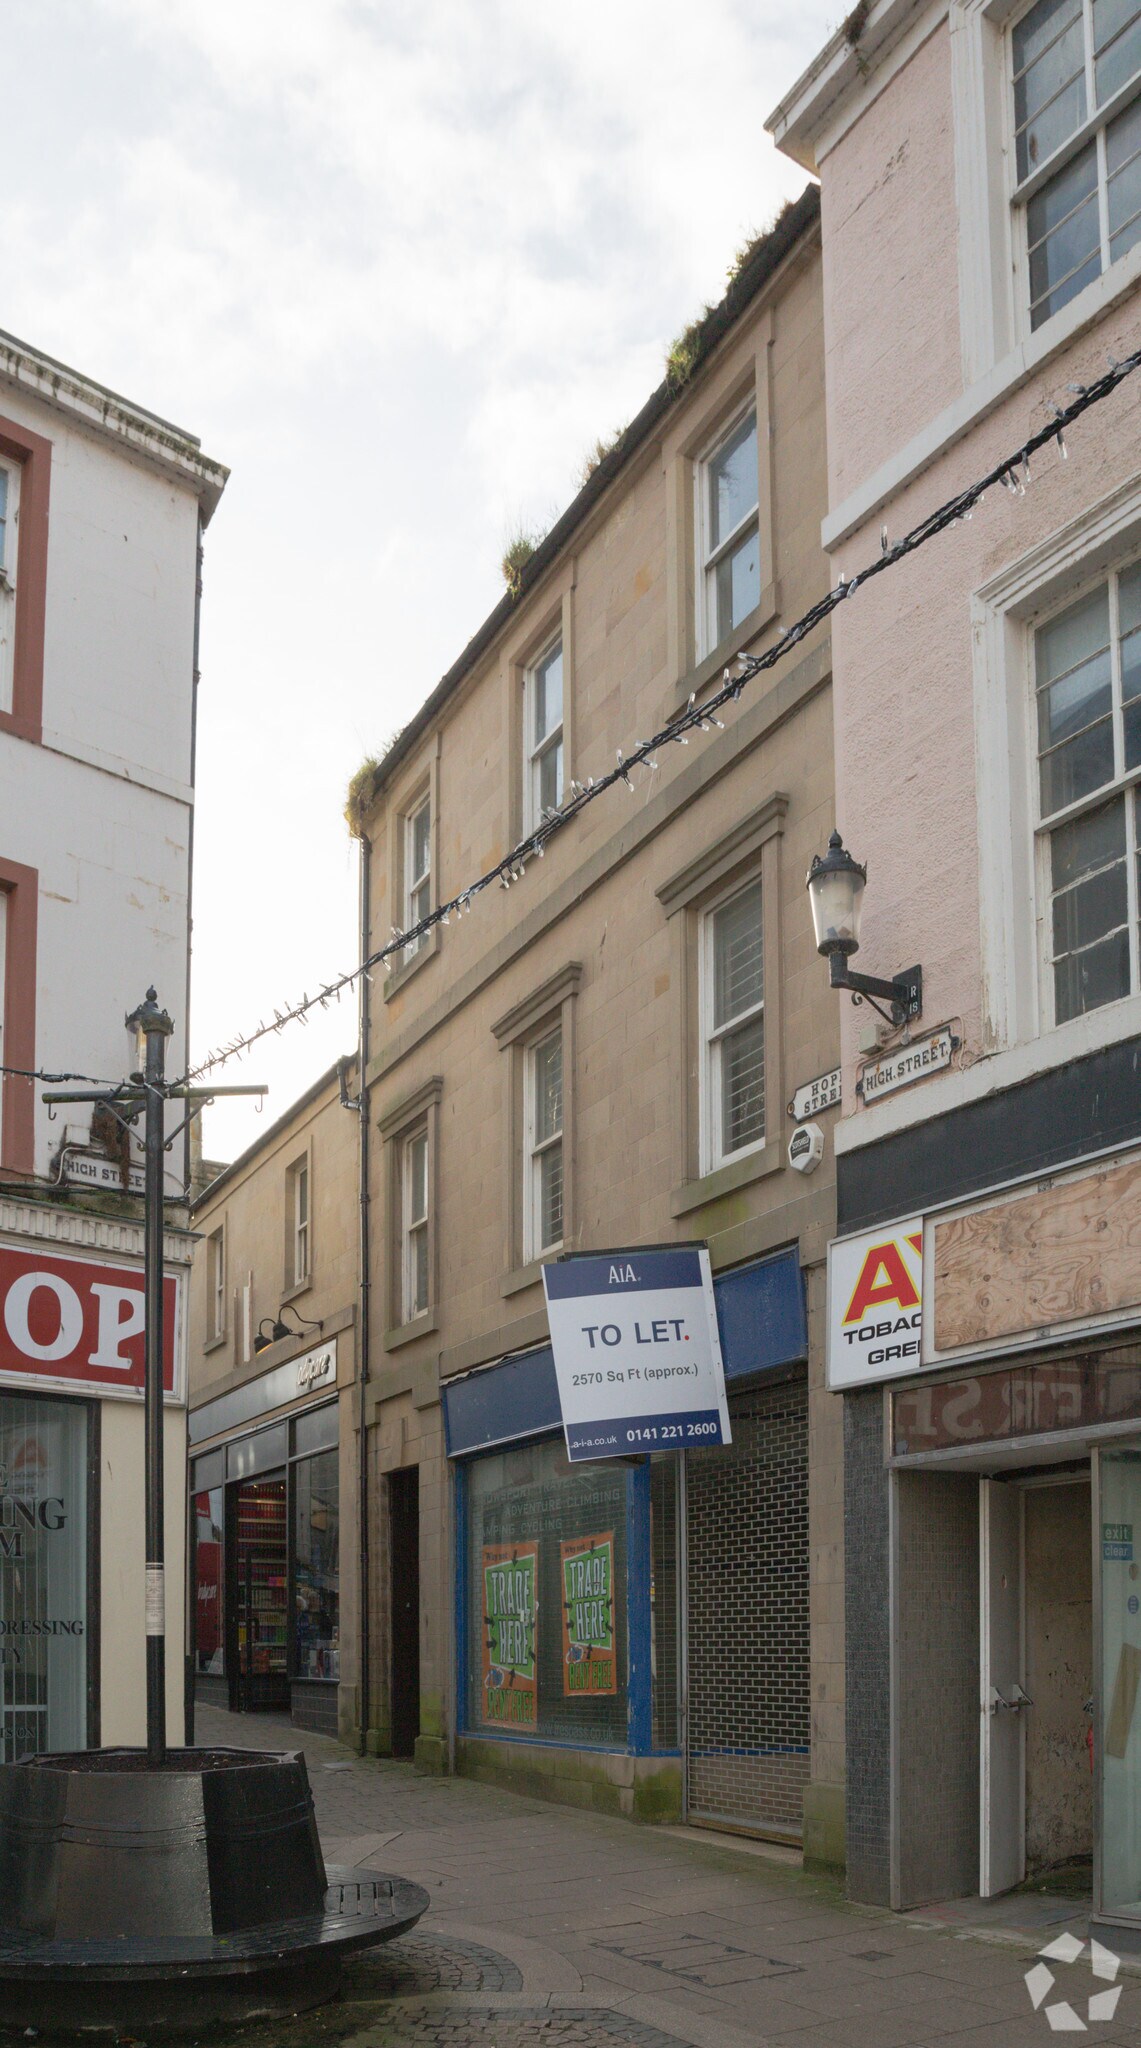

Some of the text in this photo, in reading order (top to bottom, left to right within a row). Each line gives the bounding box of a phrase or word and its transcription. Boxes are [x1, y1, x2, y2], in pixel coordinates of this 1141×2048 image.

[811, 1070, 842, 1097] HOP
[804, 1088, 842, 1114] STRE
[66, 1160, 97, 1177] HIGH
[841, 1231, 922, 1327] A
[4, 1271, 145, 1370] OP
[581, 1318, 690, 1349] TO LET.
[867, 1339, 921, 1365] GRE
[572, 1363, 699, 1387] 2570 Sq Ft (approx.)
[626, 1427, 658, 1442] 0141
[661, 1425, 683, 1439] 221
[687, 1422, 717, 1437] 2600
[504, 1488, 621, 1517] ADVENTURE CLIMBING
[521, 1518, 562, 1534] CYCLING
[1105, 1524, 1128, 1540] exit
[1104, 1546, 1128, 1557] clear
[490, 1568, 531, 1616] TRADE
[569, 1557, 607, 1600] TRADE
[575, 1600, 607, 1640] HERE
[498, 1620, 529, 1665] HERE
[569, 1660, 612, 1690] RENT FREE
